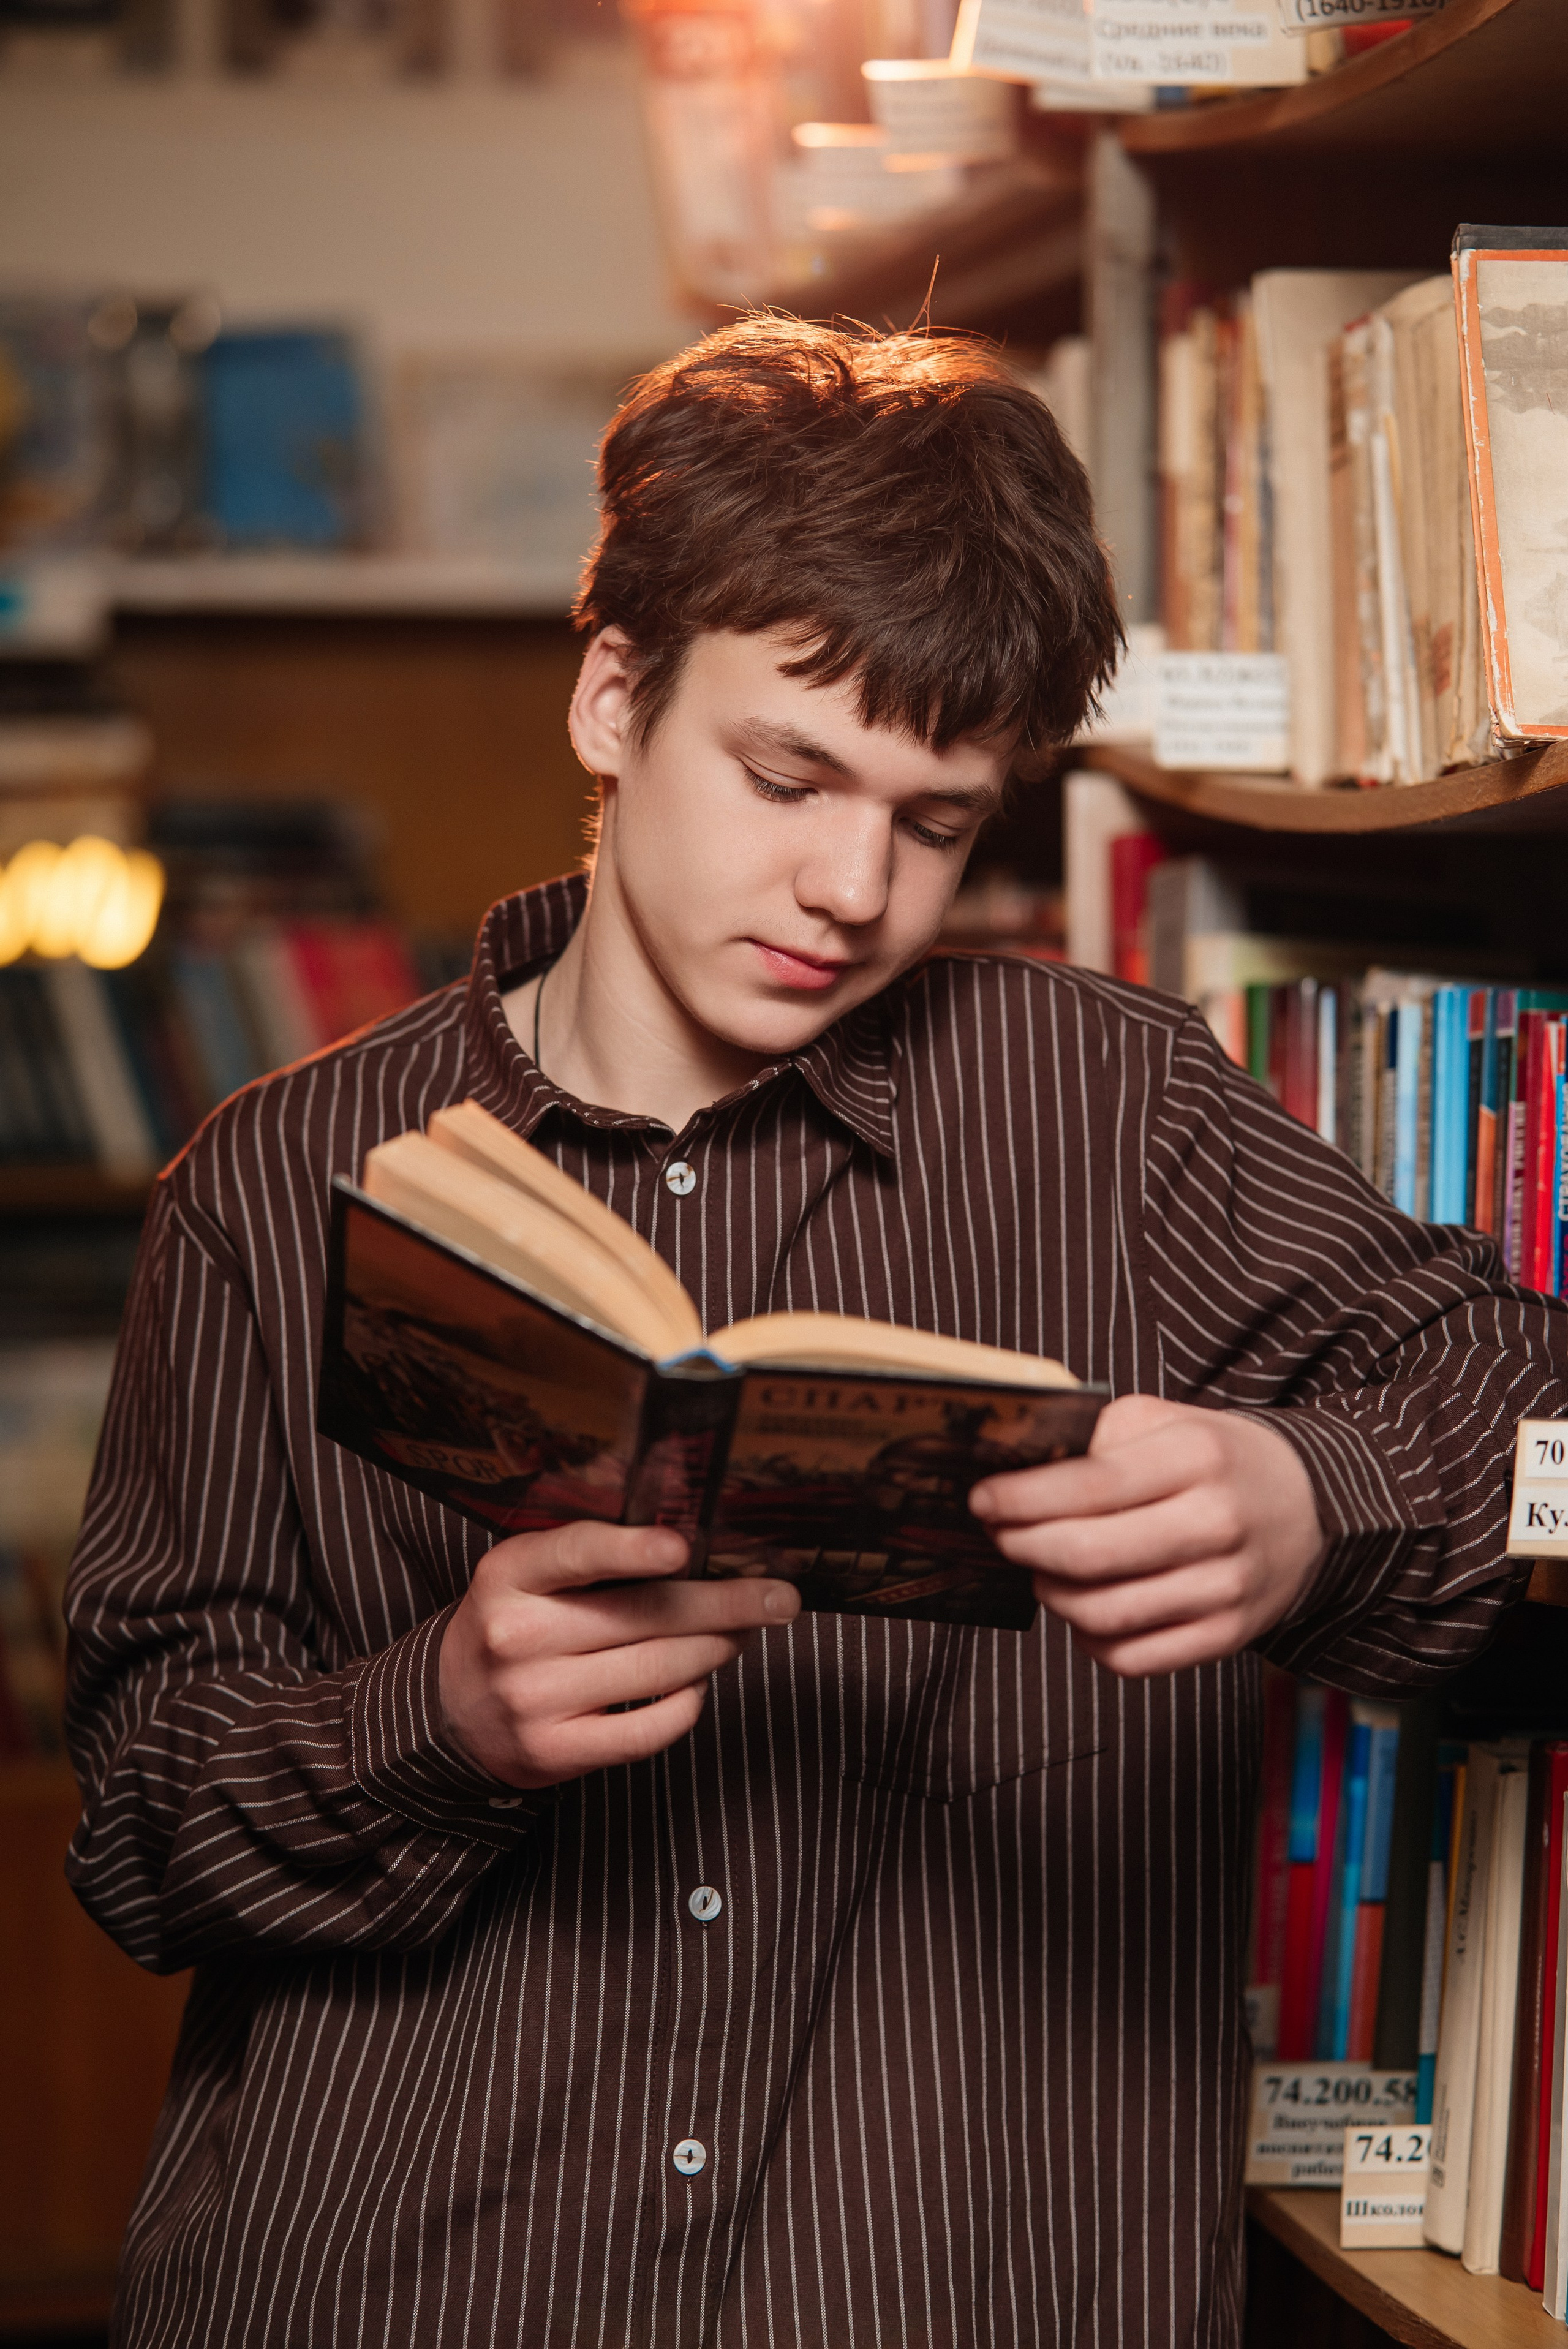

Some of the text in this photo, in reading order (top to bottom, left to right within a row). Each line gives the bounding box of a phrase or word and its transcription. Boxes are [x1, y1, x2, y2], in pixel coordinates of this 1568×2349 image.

[1535, 1440, 1565, 1465] 70
[1525, 1502, 1568, 1534] Ку
[1355, 2134, 1431, 2163] 74.2
